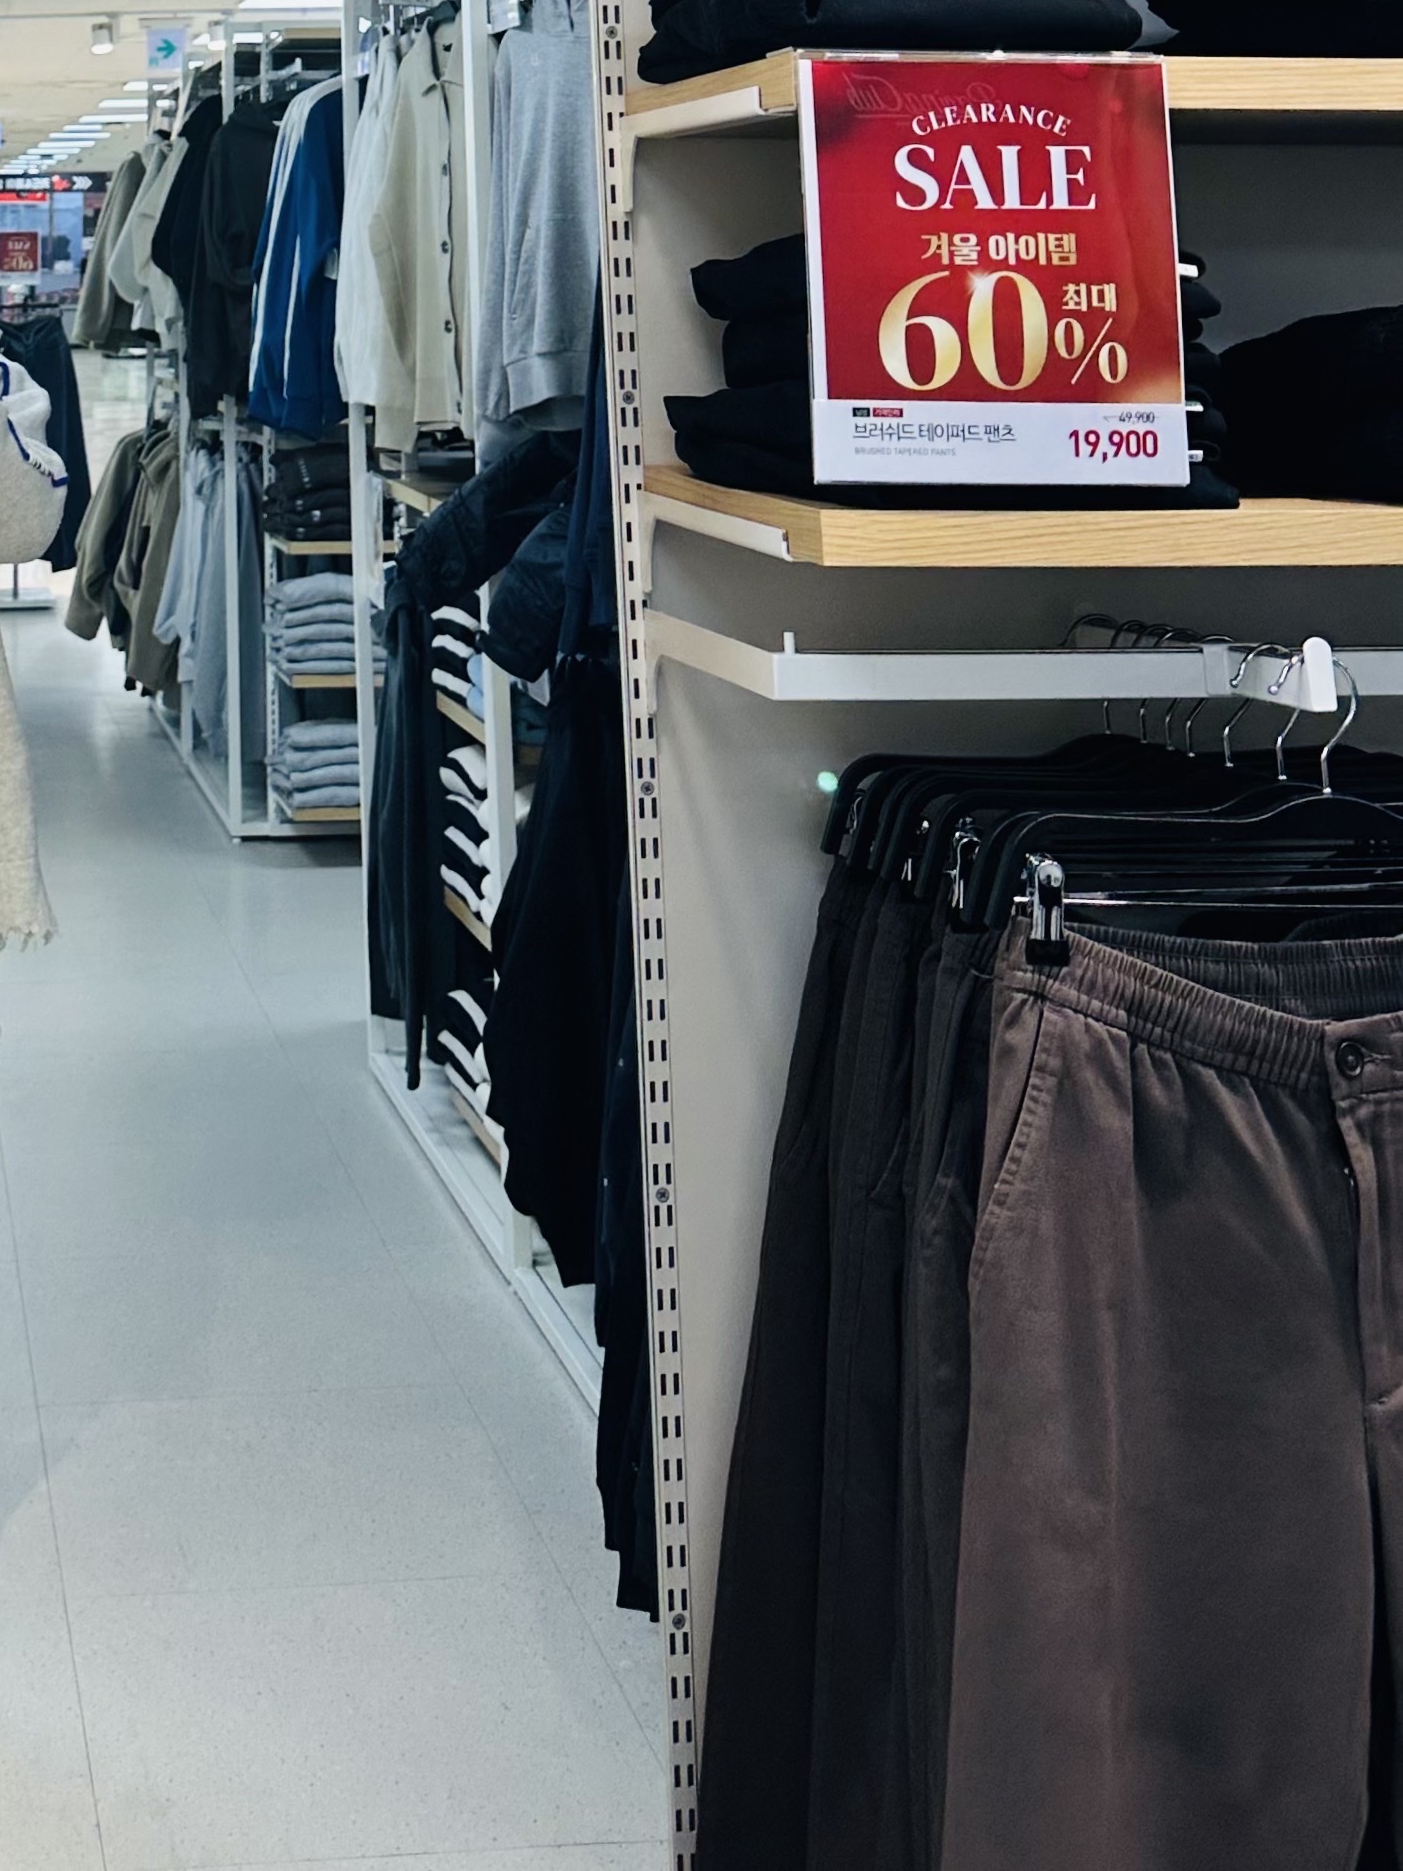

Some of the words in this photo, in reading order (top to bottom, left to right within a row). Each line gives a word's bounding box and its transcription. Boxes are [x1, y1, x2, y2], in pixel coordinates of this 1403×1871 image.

[911, 103, 1072, 137] CLEARANCE
[893, 143, 1097, 211] SALE
[920, 232, 982, 266] 겨울
[988, 232, 1078, 266] 아이템
[1062, 282, 1117, 313] 최대
[853, 422, 917, 442] 브러쉬드
[918, 422, 983, 443] 테이퍼드
[984, 424, 1017, 444] 팬츠
[1068, 429, 1159, 464] 19,900
